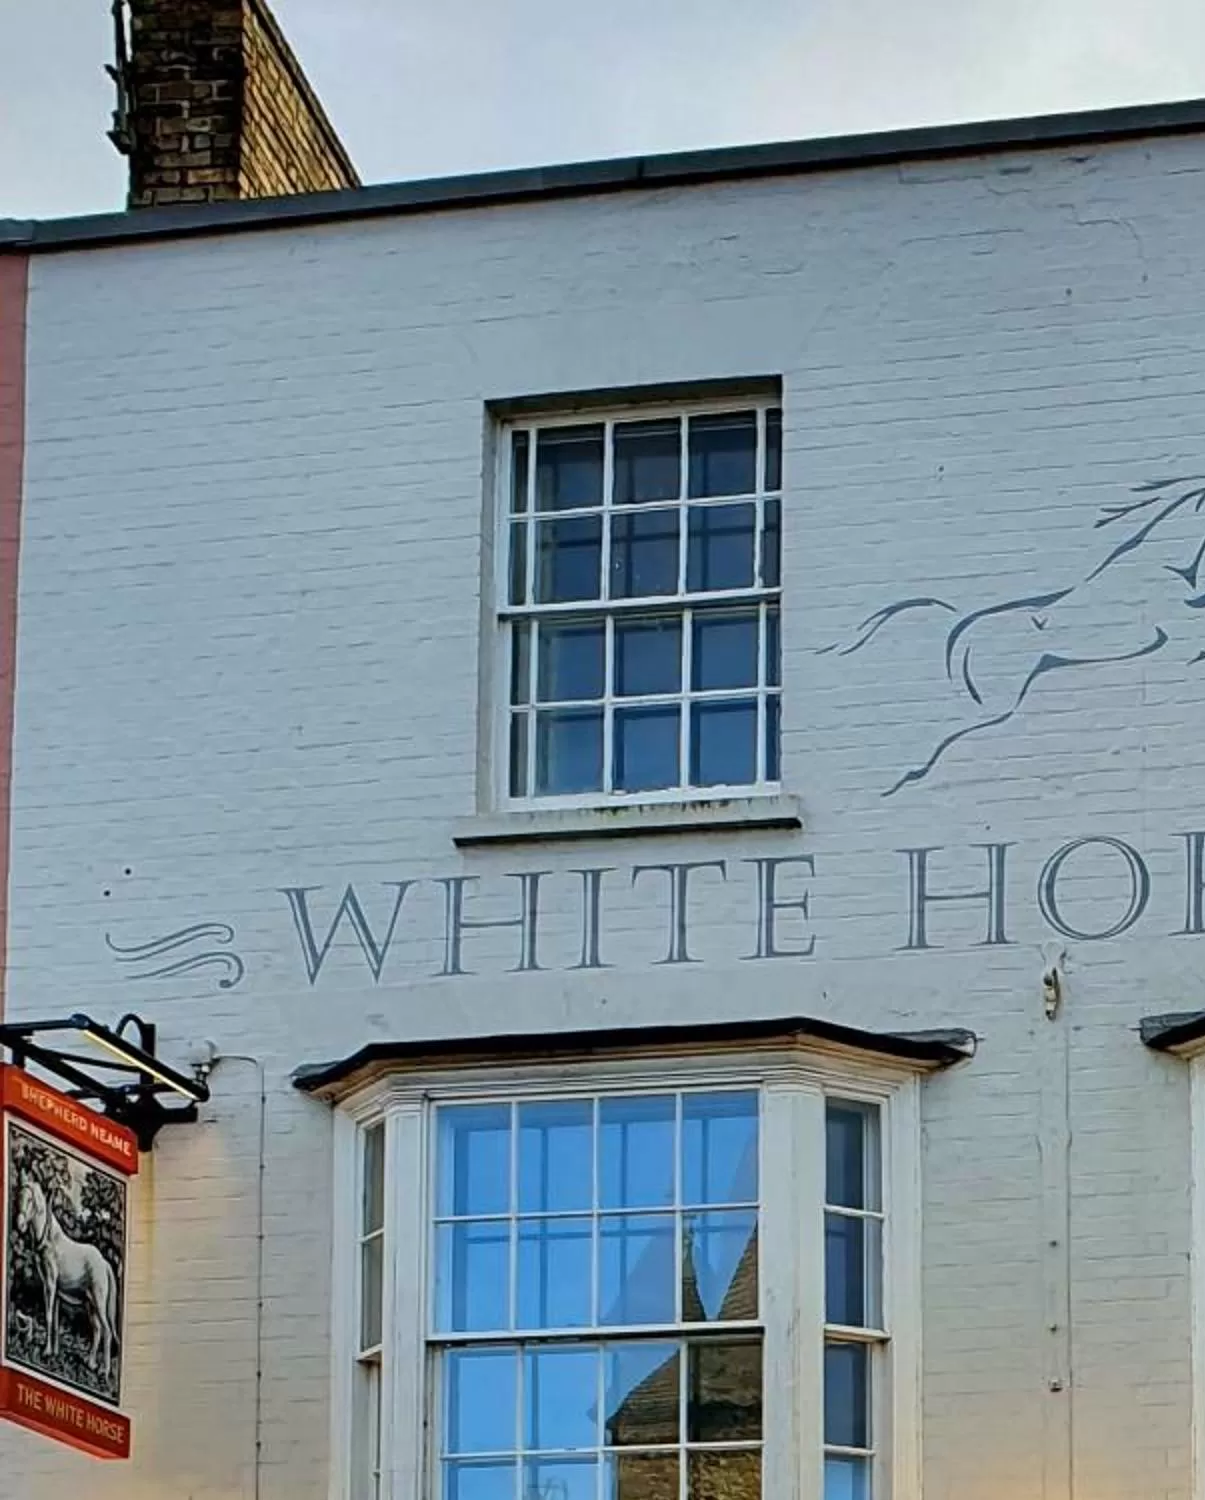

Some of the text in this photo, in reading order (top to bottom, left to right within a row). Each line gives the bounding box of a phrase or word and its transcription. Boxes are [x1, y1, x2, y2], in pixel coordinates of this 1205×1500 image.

[277, 853, 817, 985] WHITE
[21, 1081, 132, 1157] SHEPHERD NEAME
[17, 1383, 125, 1445] THE WHITE HORSE
